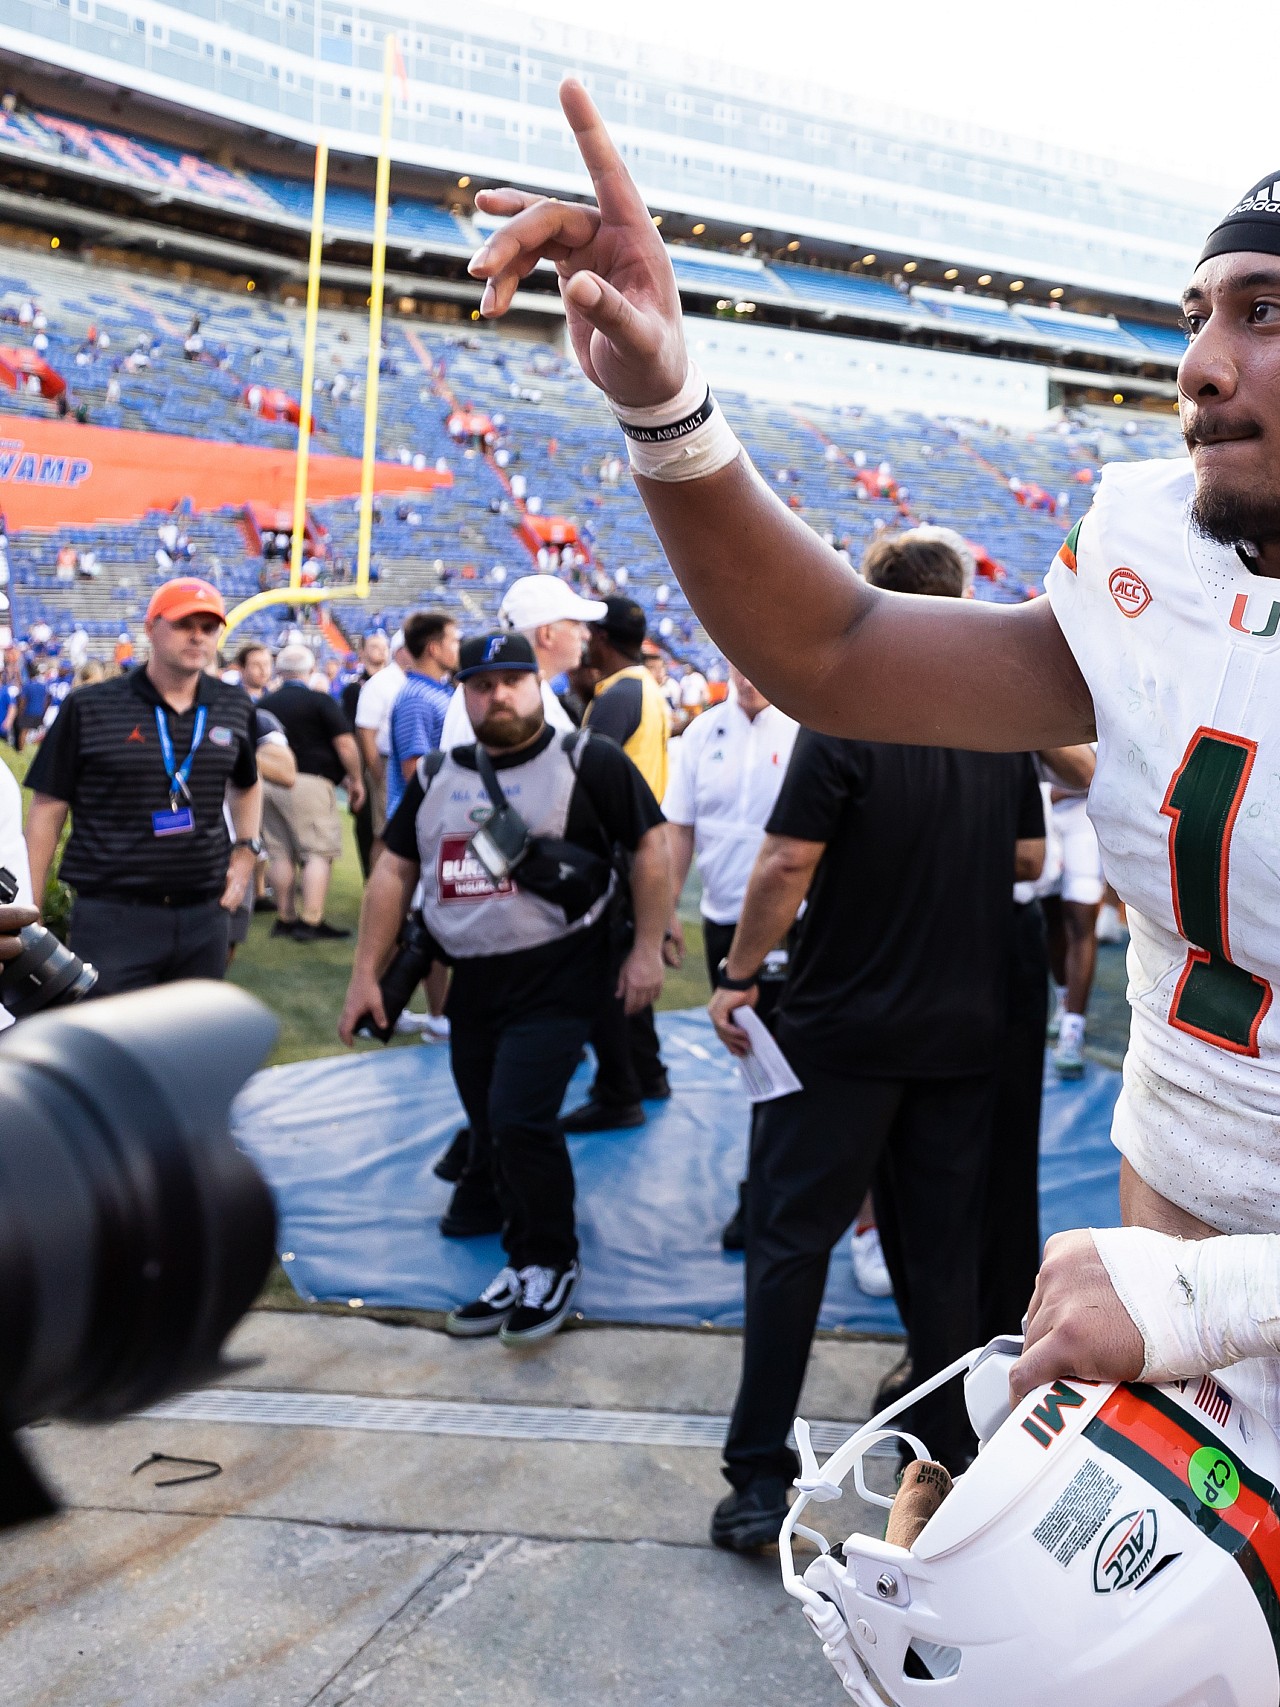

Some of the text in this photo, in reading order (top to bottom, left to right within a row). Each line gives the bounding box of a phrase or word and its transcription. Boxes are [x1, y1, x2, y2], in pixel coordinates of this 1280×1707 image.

[657, 411, 703, 440] ASSAULT
[1114, 580, 1142, 600] ACC
[1159, 725, 1273, 1059] 1
[1204, 1458, 1231, 1503] C2P
[1081, 1508, 1112, 1550] WARNING
[1105, 1518, 1145, 1589] ACC
